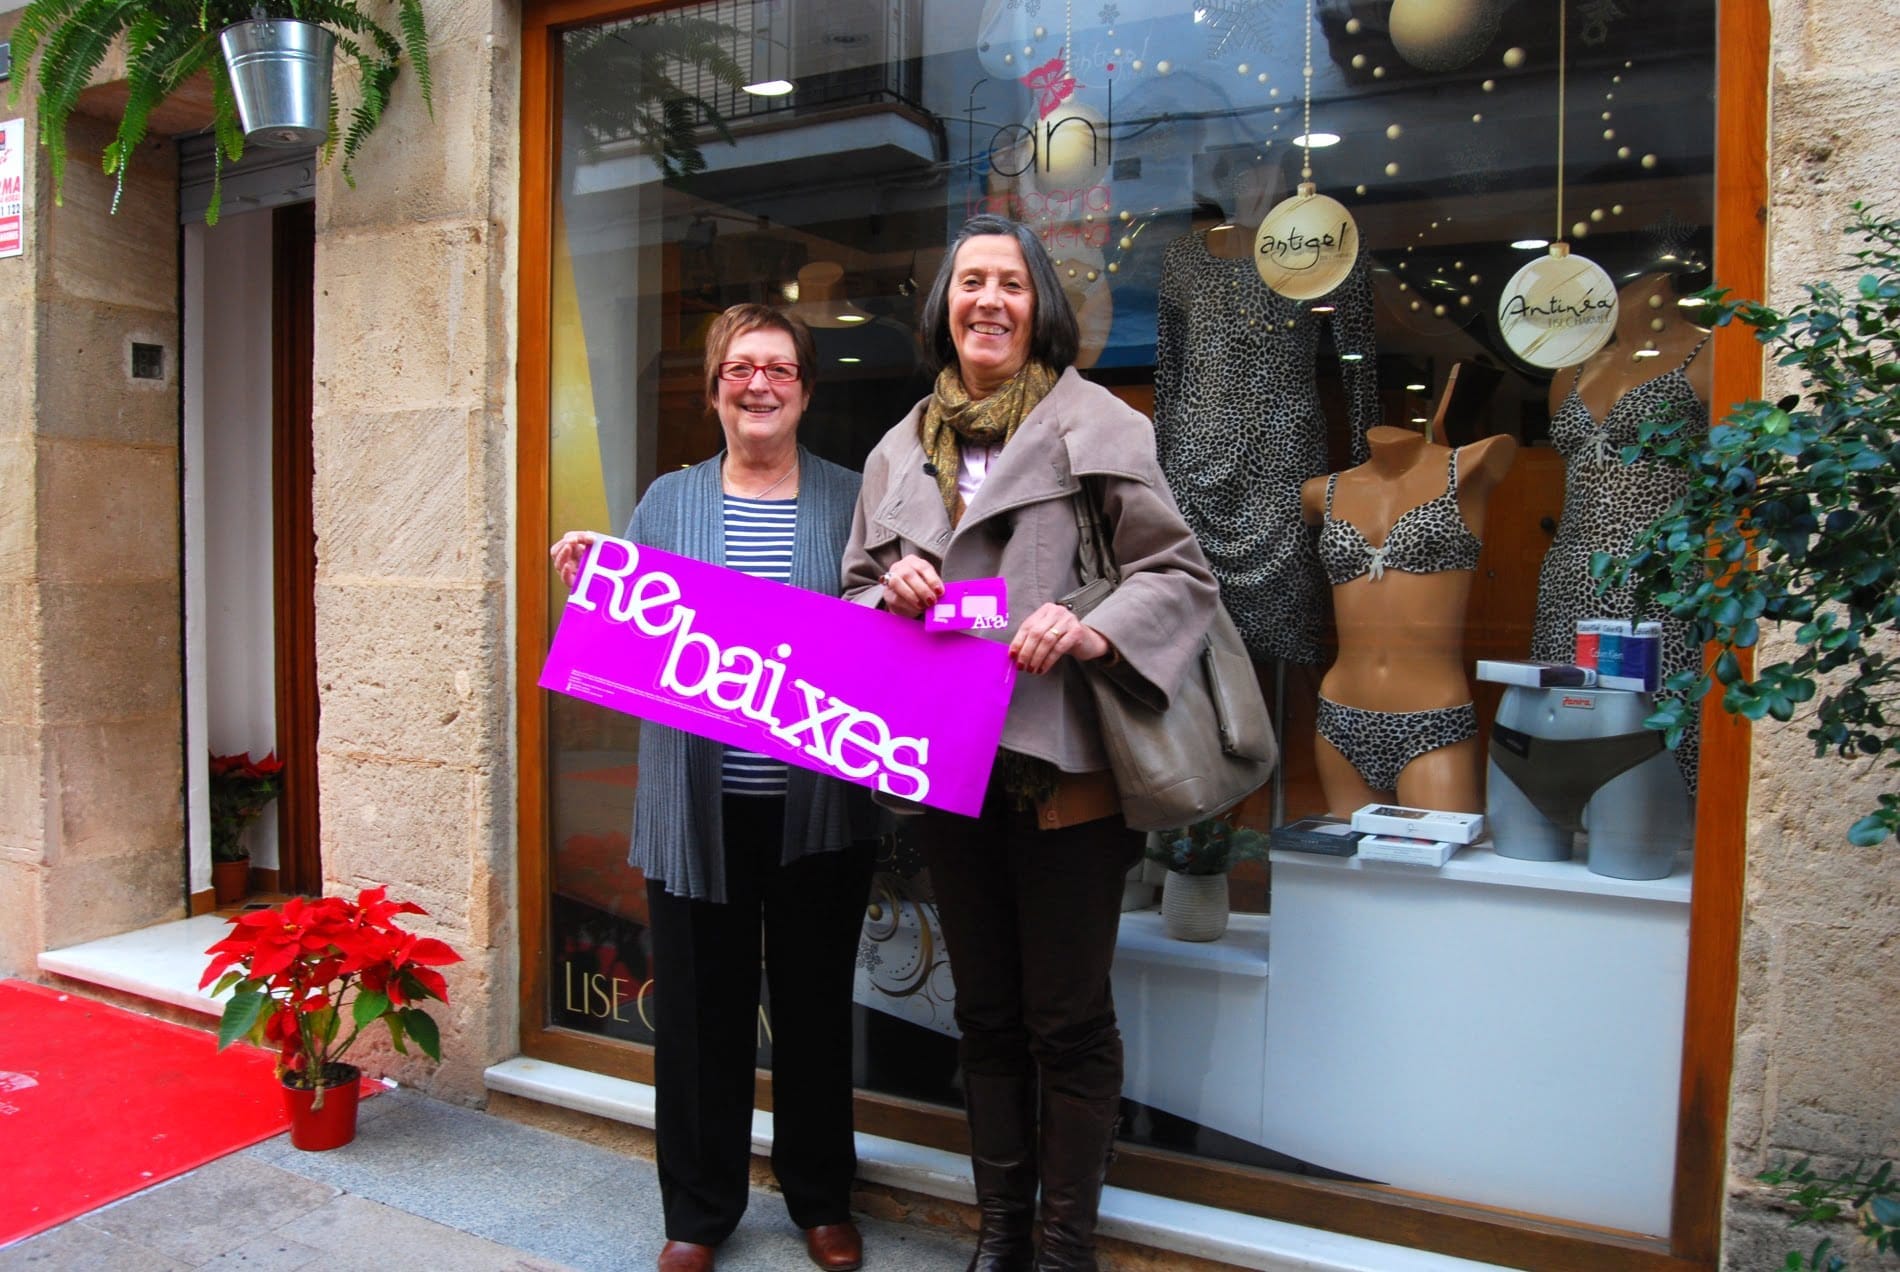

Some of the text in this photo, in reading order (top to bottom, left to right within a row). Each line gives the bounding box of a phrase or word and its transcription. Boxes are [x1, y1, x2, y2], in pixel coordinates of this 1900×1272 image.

[0, 176, 20, 195] MA
[1260, 221, 1346, 270] antigel
[1500, 287, 1617, 321] Antinéa
[567, 534, 930, 802] Rebaixes
[565, 961, 630, 1024] LISE
